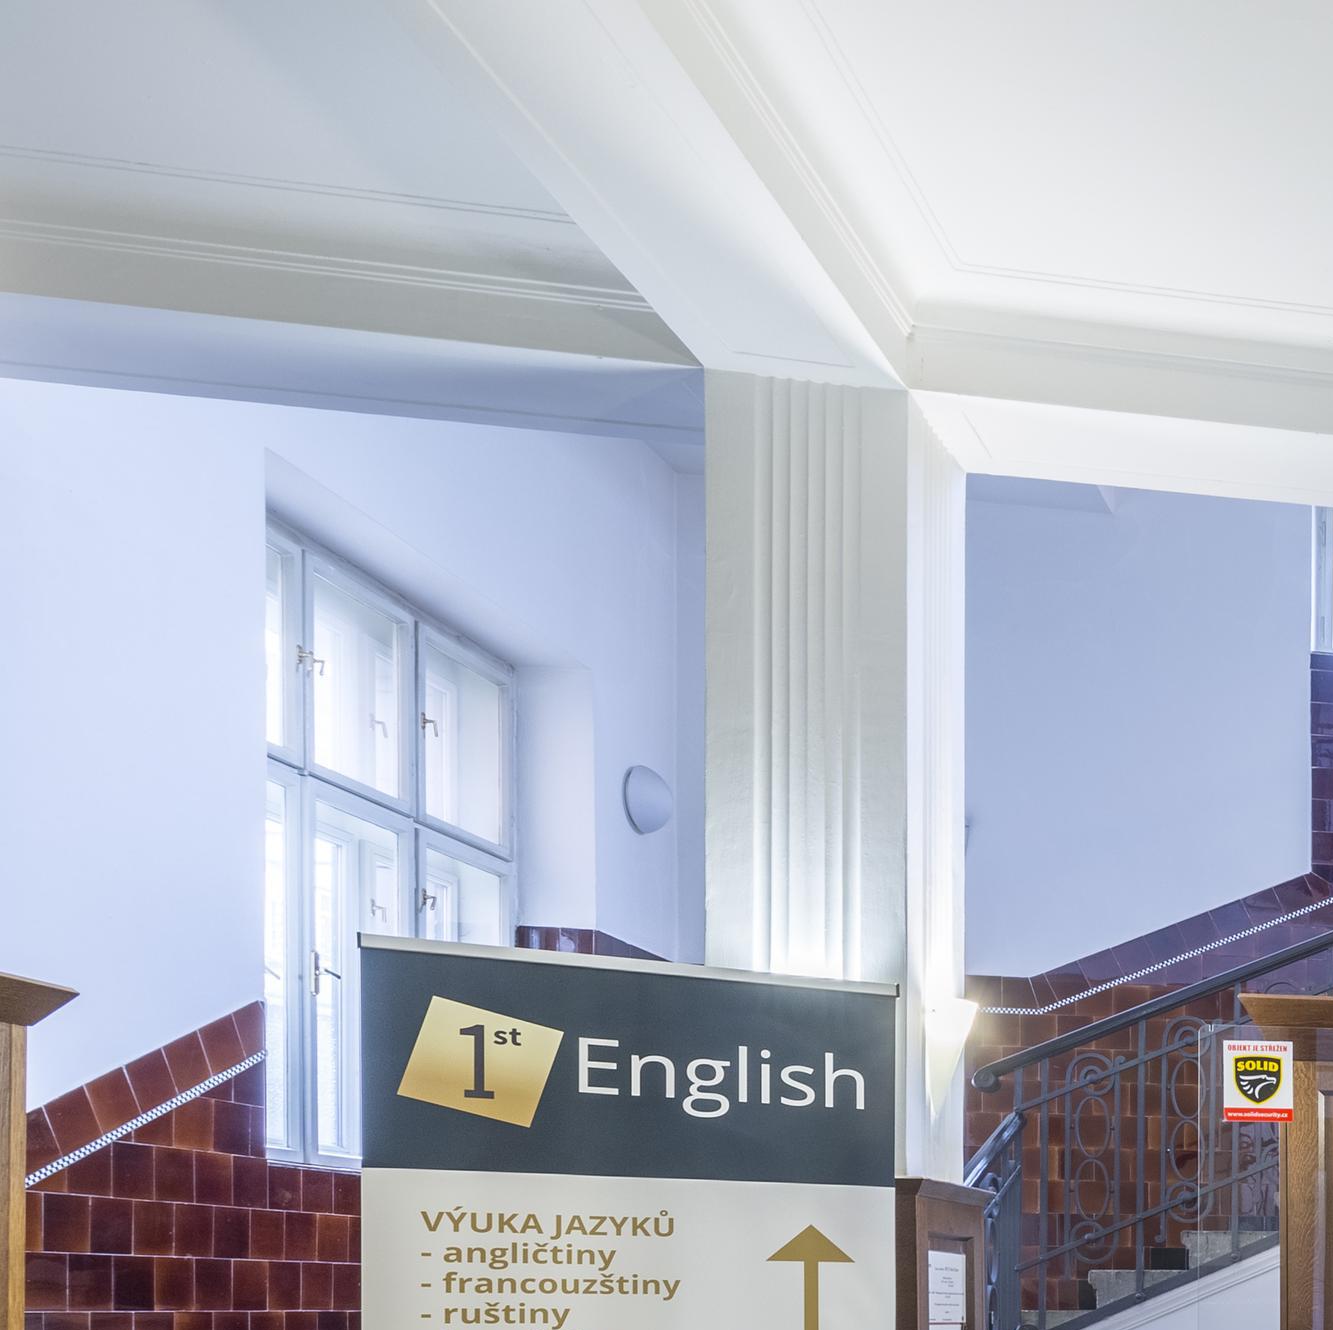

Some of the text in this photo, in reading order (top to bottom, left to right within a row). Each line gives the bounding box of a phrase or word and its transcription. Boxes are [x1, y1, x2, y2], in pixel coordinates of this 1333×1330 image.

[1227, 1044, 1251, 1052] OBJEKT
[1253, 1044, 1259, 1052] JE
[459, 1023, 865, 1118] 1st English
[1236, 1060, 1279, 1072] SOLID
[420, 1206, 675, 1240] VÝUKA JAZYKŮ
[443, 1242, 617, 1271] angličtiny
[443, 1272, 681, 1300] francouzštiny
[443, 1303, 571, 1330] ruštiny
